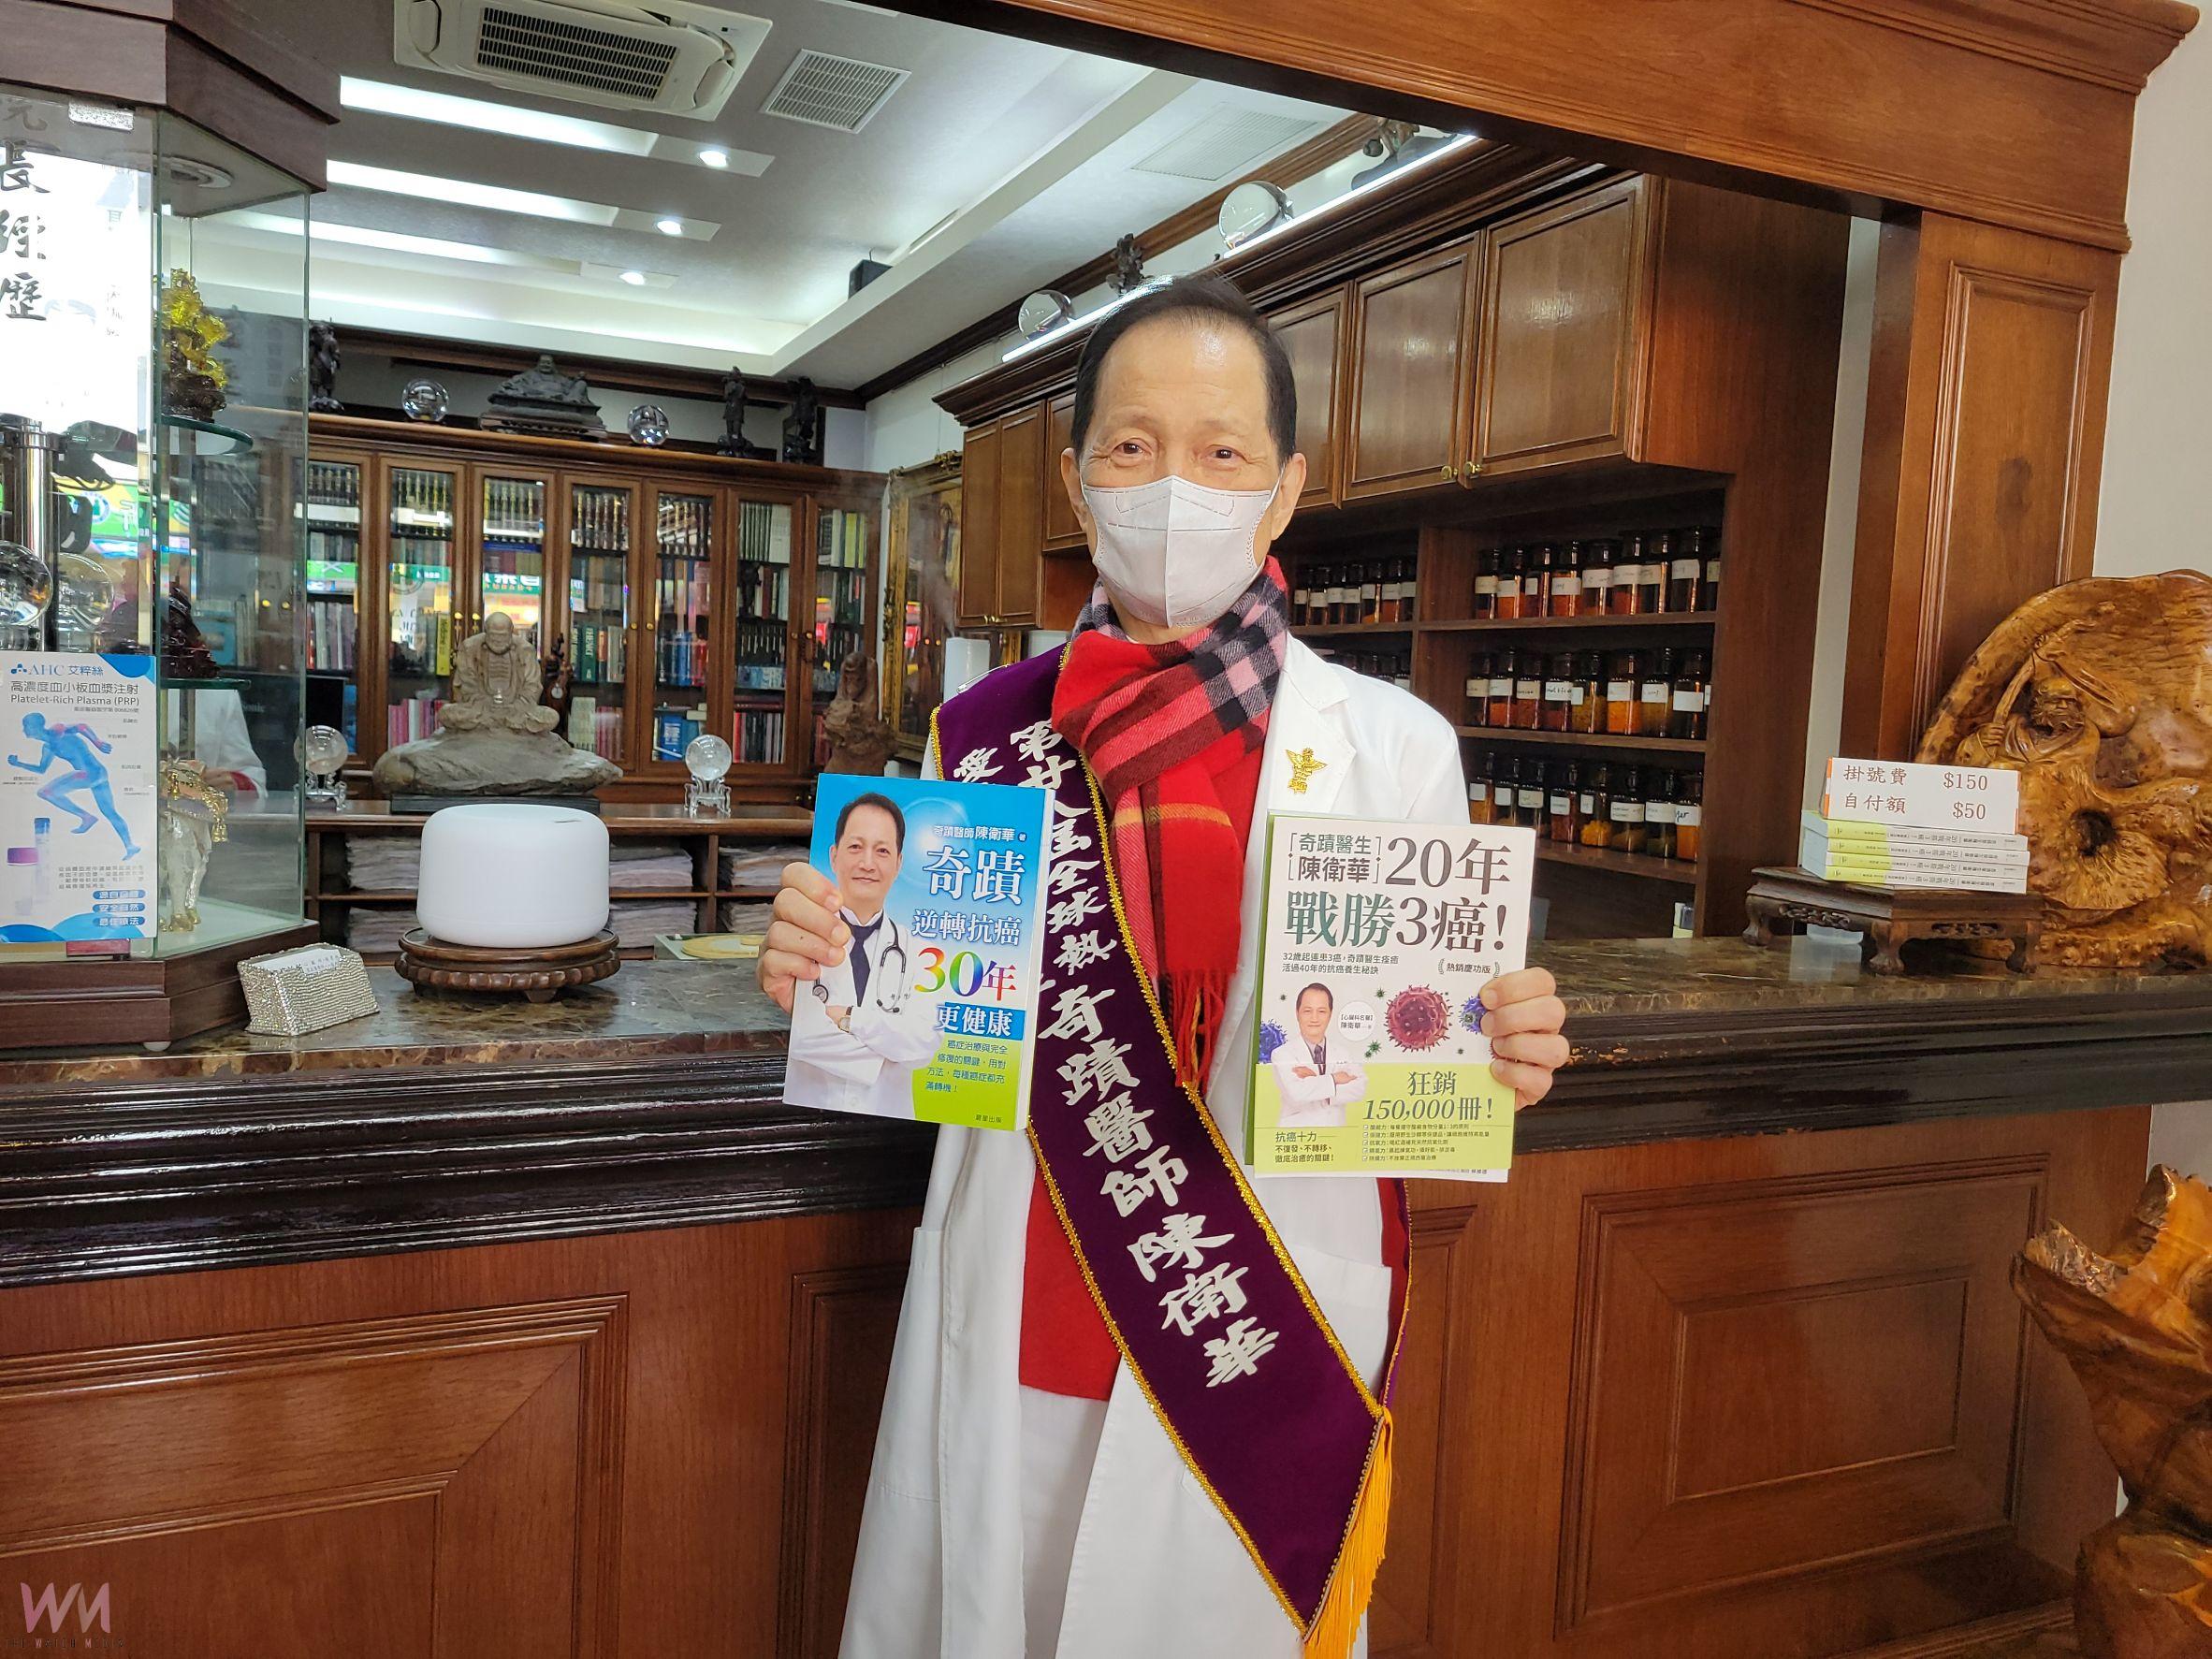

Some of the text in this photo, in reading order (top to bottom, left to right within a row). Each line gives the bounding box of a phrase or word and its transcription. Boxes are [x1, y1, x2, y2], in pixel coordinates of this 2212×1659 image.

[10, 680, 138, 695] 高濃度血小板血漿注射
[10, 694, 139, 706] Platelet-Rich Plasma (PRP)
[1843, 764, 1988, 791] 掛號費 $150
[1844, 792, 1986, 820] 自付額 $50
[1299, 833, 1372, 855] 奇蹟醫生
[923, 845, 1026, 906] 奇蹟
[1298, 856, 1371, 883] 陳衛華
[1385, 837, 1512, 895] 20年
[912, 909, 1022, 947] 逆轉抗癌
[1284, 890, 1507, 953] 戰勝3癌！
[914, 947, 1017, 1001] 30年
[1446, 962, 1491, 974] 熱銷慶功版
[936, 1005, 1013, 1037] 更健康
[1407, 1070, 1457, 1096] 狂銷
[1362, 1097, 1492, 1120] 150,000冊！
[1275, 1131, 1317, 1142] 抗癌十力
[1037, 984, 1280, 1389] 奇蹟醫師陳衛華
